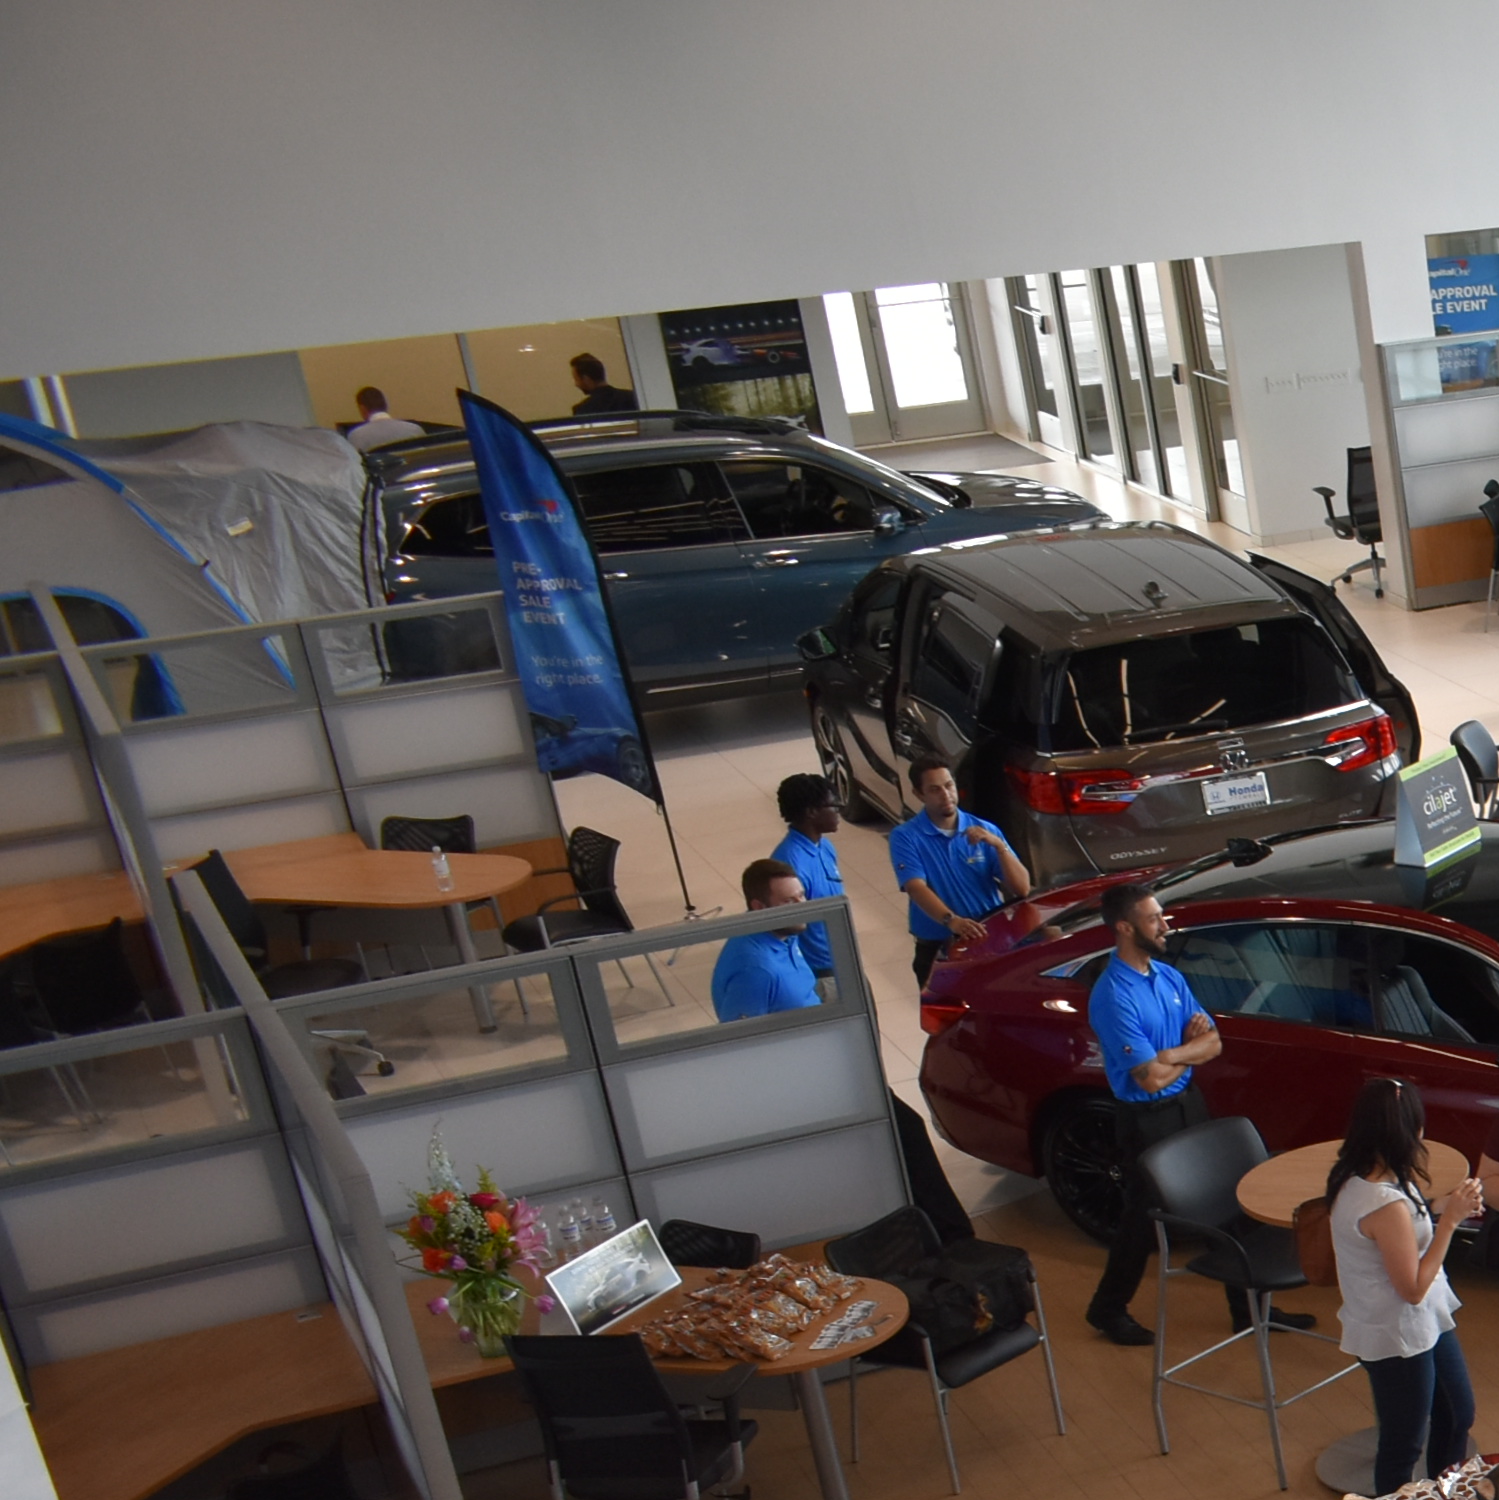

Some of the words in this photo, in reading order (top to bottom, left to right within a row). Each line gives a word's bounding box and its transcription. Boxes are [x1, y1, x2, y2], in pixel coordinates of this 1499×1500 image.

[1431, 284, 1498, 300] APPROVAL
[1446, 299, 1488, 313] EVENT
[512, 561, 542, 576] PRE-
[516, 577, 583, 592] APPROVAL
[519, 594, 551, 609] SALE
[523, 611, 565, 625] EVENT
[584, 653, 604, 666] the
[535, 673, 565, 688] right
[1229, 783, 1265, 797] Honda
[1423, 787, 1457, 815] cilajet
[1110, 847, 1167, 860] ODYSSEY
